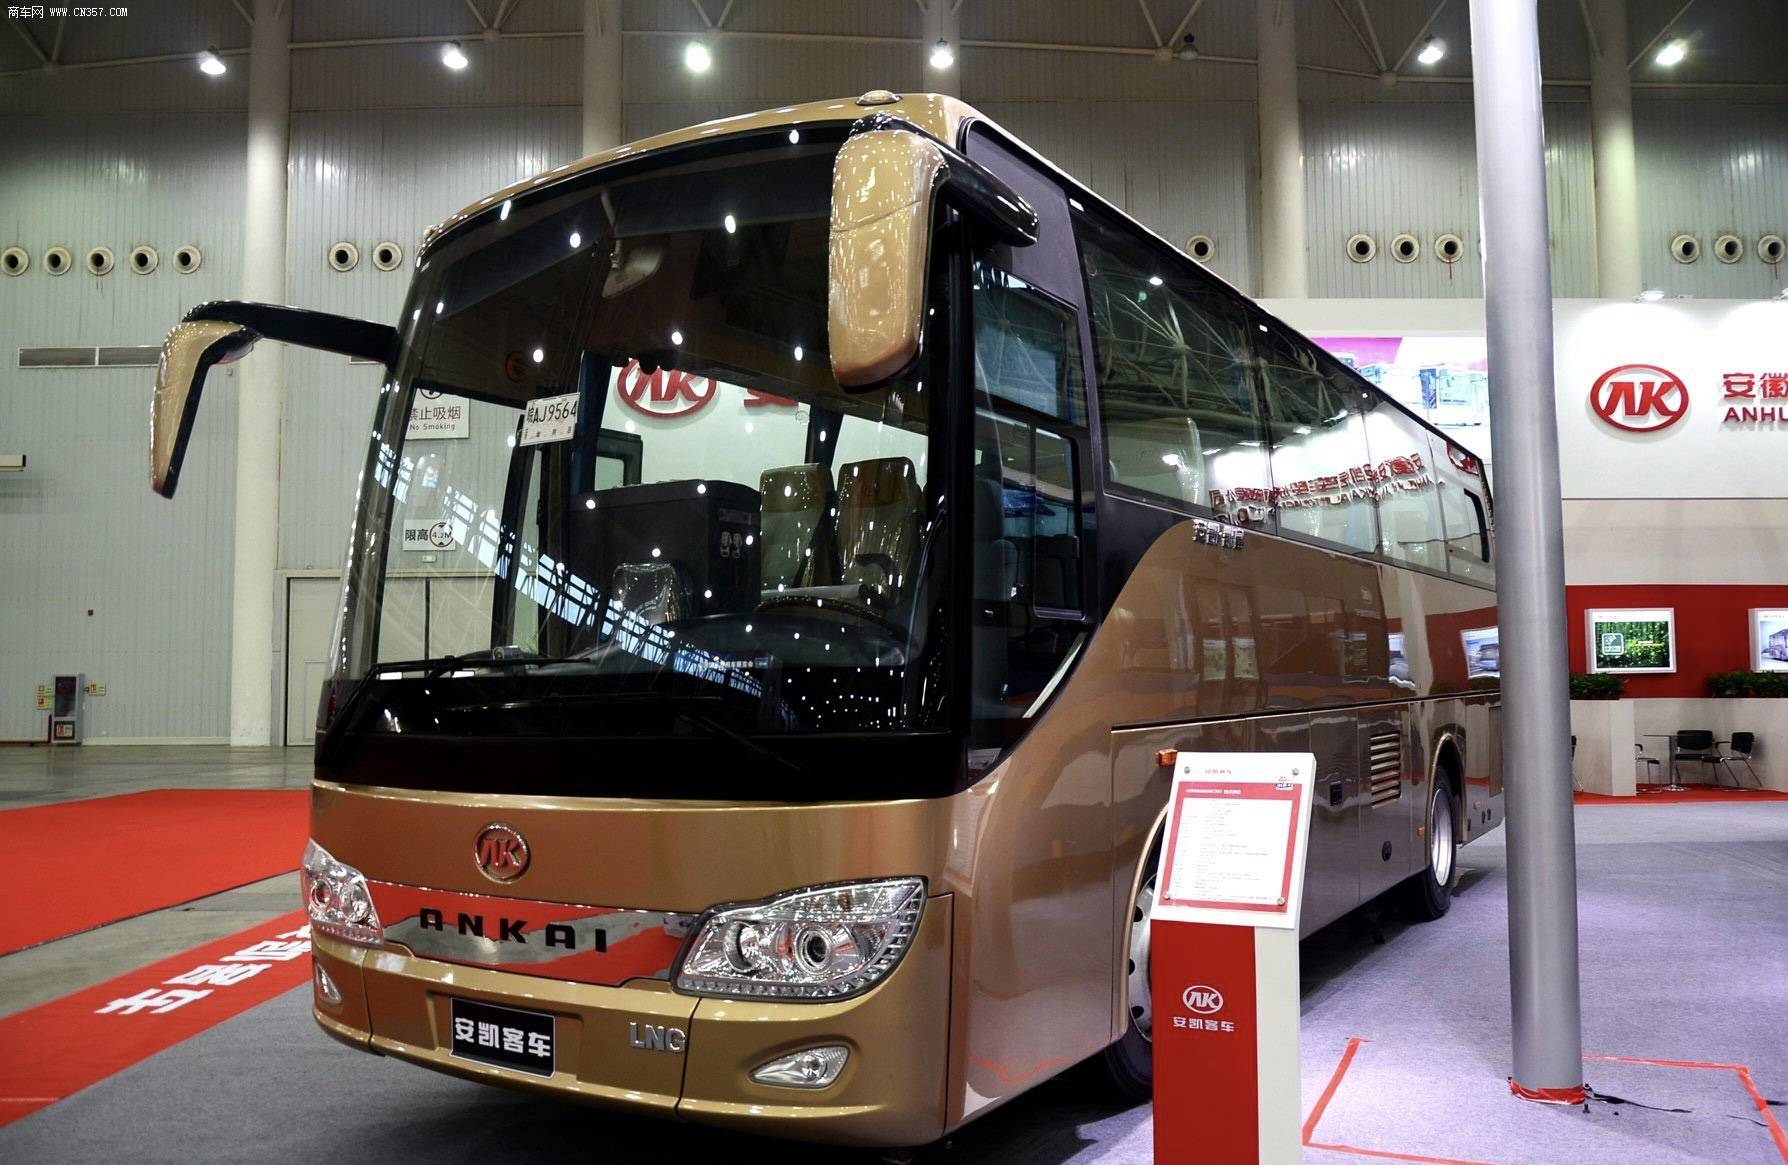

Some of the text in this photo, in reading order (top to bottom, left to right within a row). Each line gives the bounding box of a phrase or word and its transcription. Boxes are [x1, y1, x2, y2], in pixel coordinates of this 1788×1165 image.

[1722, 372, 1788, 399] 安徽
[410, 406, 461, 420] 禁止吸烟
[423, 423, 456, 432] Smoking
[405, 528, 429, 541] 限高
[419, 907, 608, 953] ANKAI
[1172, 1016, 1235, 1033] 安凯客车
[454, 1017, 552, 1058] 安凯客车
[628, 1021, 687, 1053] LNG
